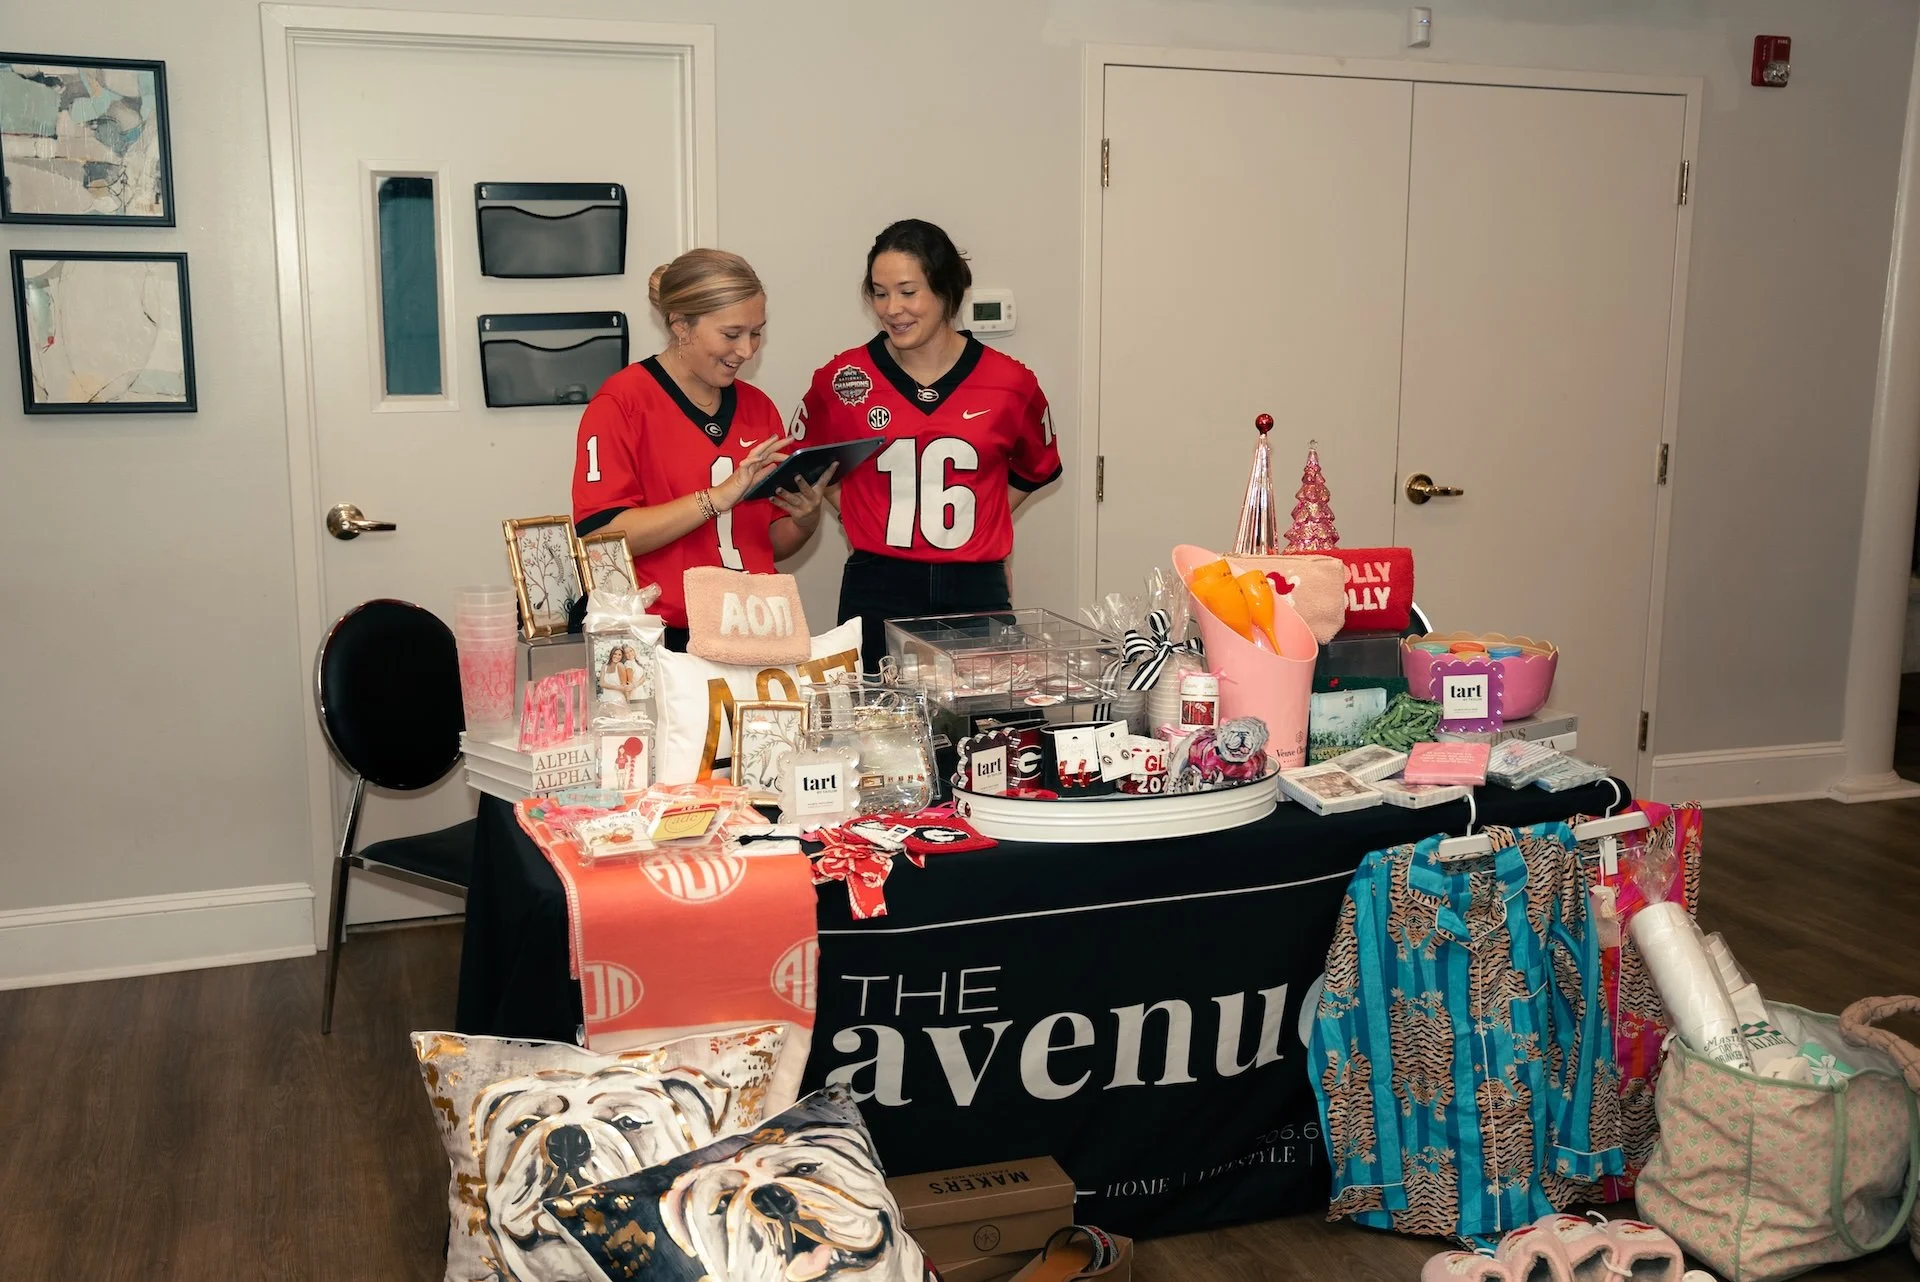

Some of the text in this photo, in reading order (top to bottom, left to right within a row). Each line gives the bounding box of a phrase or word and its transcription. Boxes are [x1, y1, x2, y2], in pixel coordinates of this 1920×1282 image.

[834, 380, 870, 390] CHAMPIONS
[870, 408, 889, 428] SEC
[586, 435, 601, 482] 1
[876, 437, 979, 549] 16
[710, 456, 745, 571] 1
[1450, 684, 1482, 698] tart
[535, 748, 591, 771] ALPHA
[977, 757, 1002, 776] tart
[535, 768, 592, 790] ALPHA
[803, 774, 837, 791] tart
[841, 966, 1001, 1017] THE
[825, 982, 1325, 1107] avenu
[929, 1170, 1031, 1194] MAKER'S
[1106, 1177, 1170, 1198] HOME
